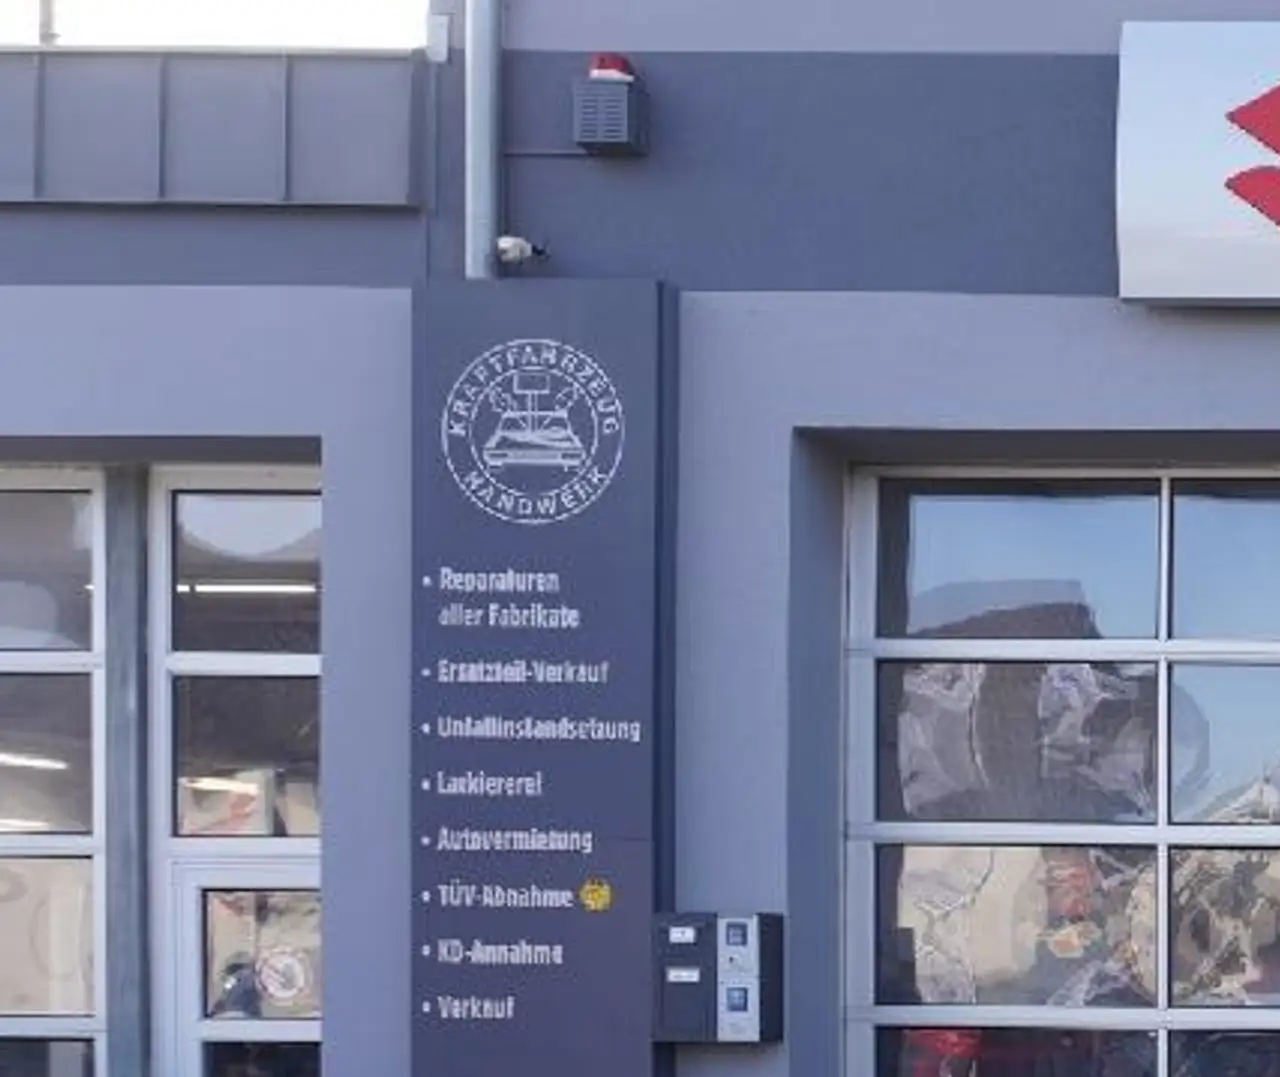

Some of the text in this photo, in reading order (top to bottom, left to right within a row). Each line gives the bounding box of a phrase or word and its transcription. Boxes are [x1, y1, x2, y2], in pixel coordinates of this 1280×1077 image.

[449, 346, 620, 436] KRAFTFAHRZEUG
[464, 467, 608, 515] HANDWERK
[440, 567, 560, 592] Reparaturen
[438, 603, 581, 628] aller Fabrikate
[438, 660, 609, 683] Ersatzteil-Verkauf
[438, 716, 641, 742] Unfallinstandsetzung
[437, 771, 542, 796] Lackiererei
[437, 827, 593, 853] Autovermietung
[437, 879, 574, 907] TÜV-Abnahme
[437, 940, 563, 965] KD-Annahme
[437, 996, 515, 1019] Verkauf
